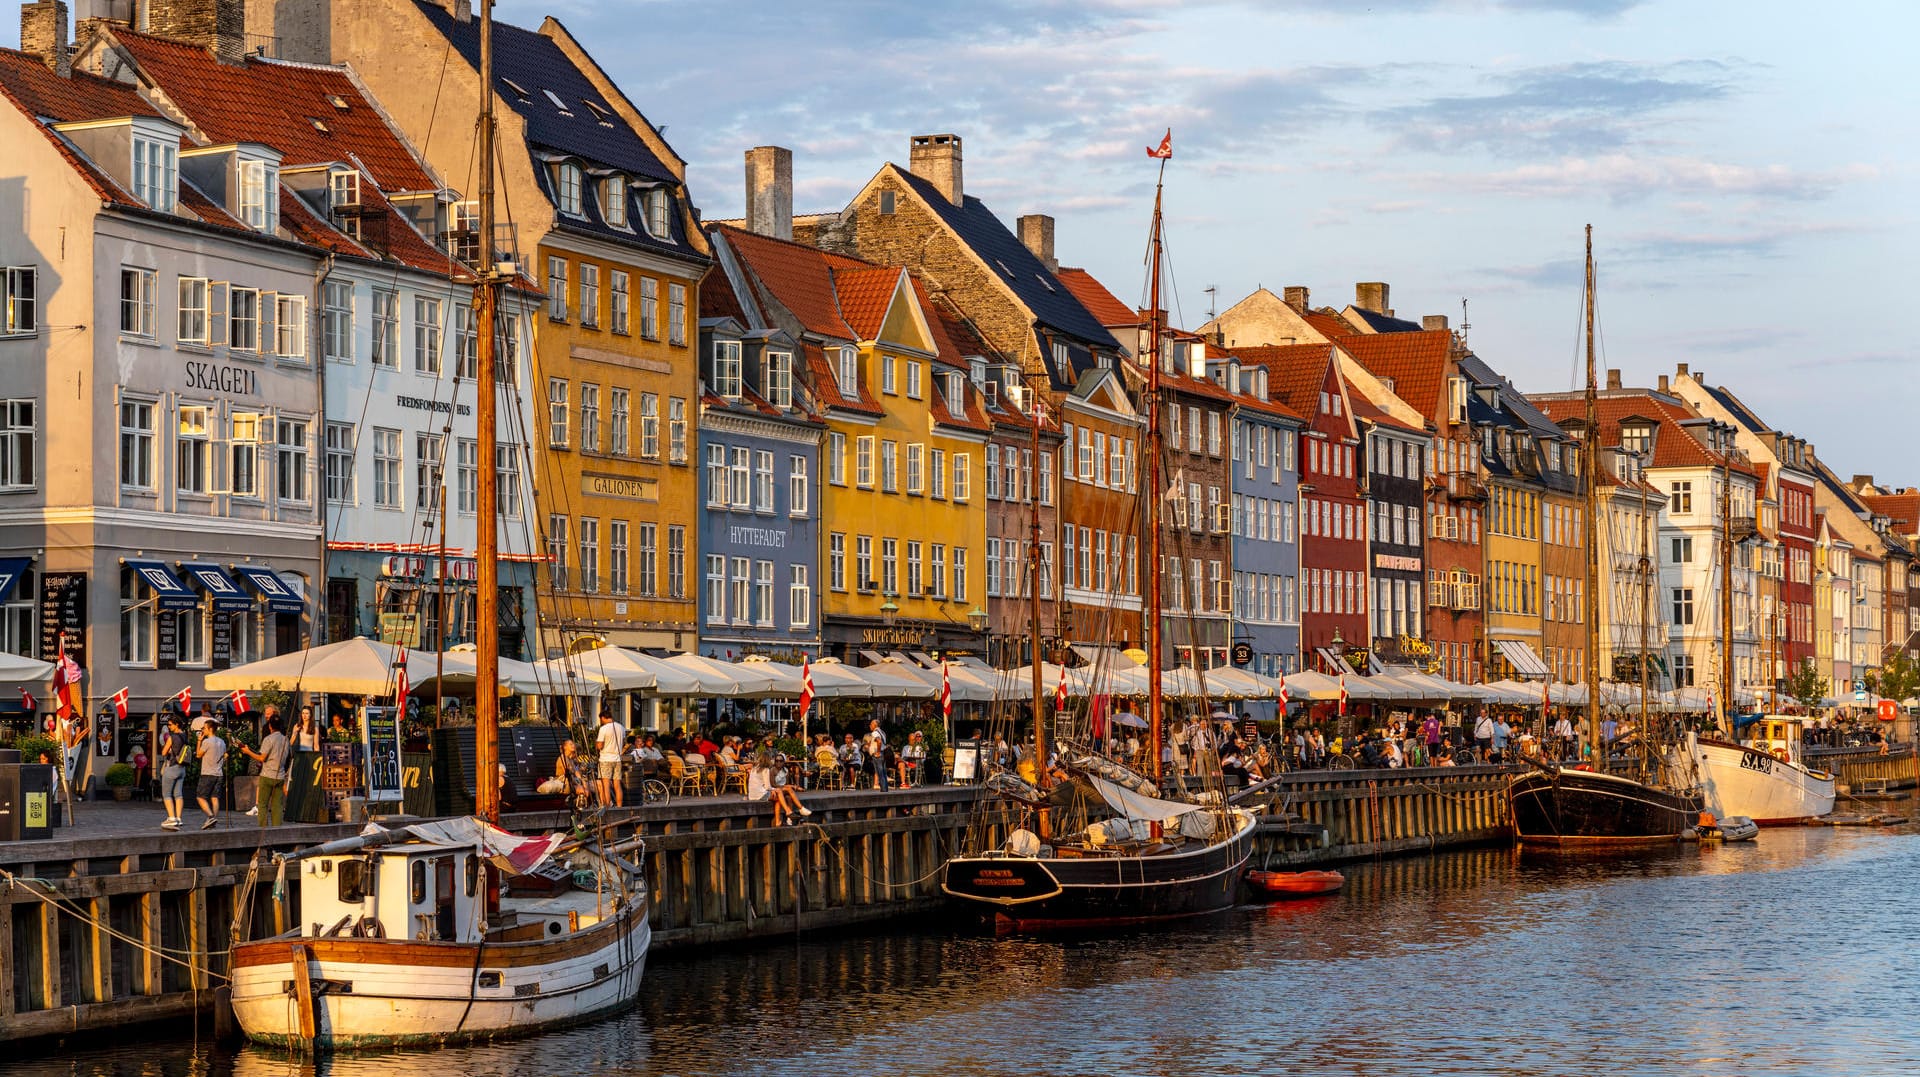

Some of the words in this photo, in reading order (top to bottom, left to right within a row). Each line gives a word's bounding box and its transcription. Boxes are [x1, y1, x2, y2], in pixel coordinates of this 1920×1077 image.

[186, 361, 256, 395] SKAGEN
[397, 395, 451, 414] FREDSFONDENS
[456, 404, 470, 416] HUS
[594, 478, 643, 497] GALIONEN
[730, 526, 786, 548] HYTTEFADET
[1354, 651, 1368, 664] 37
